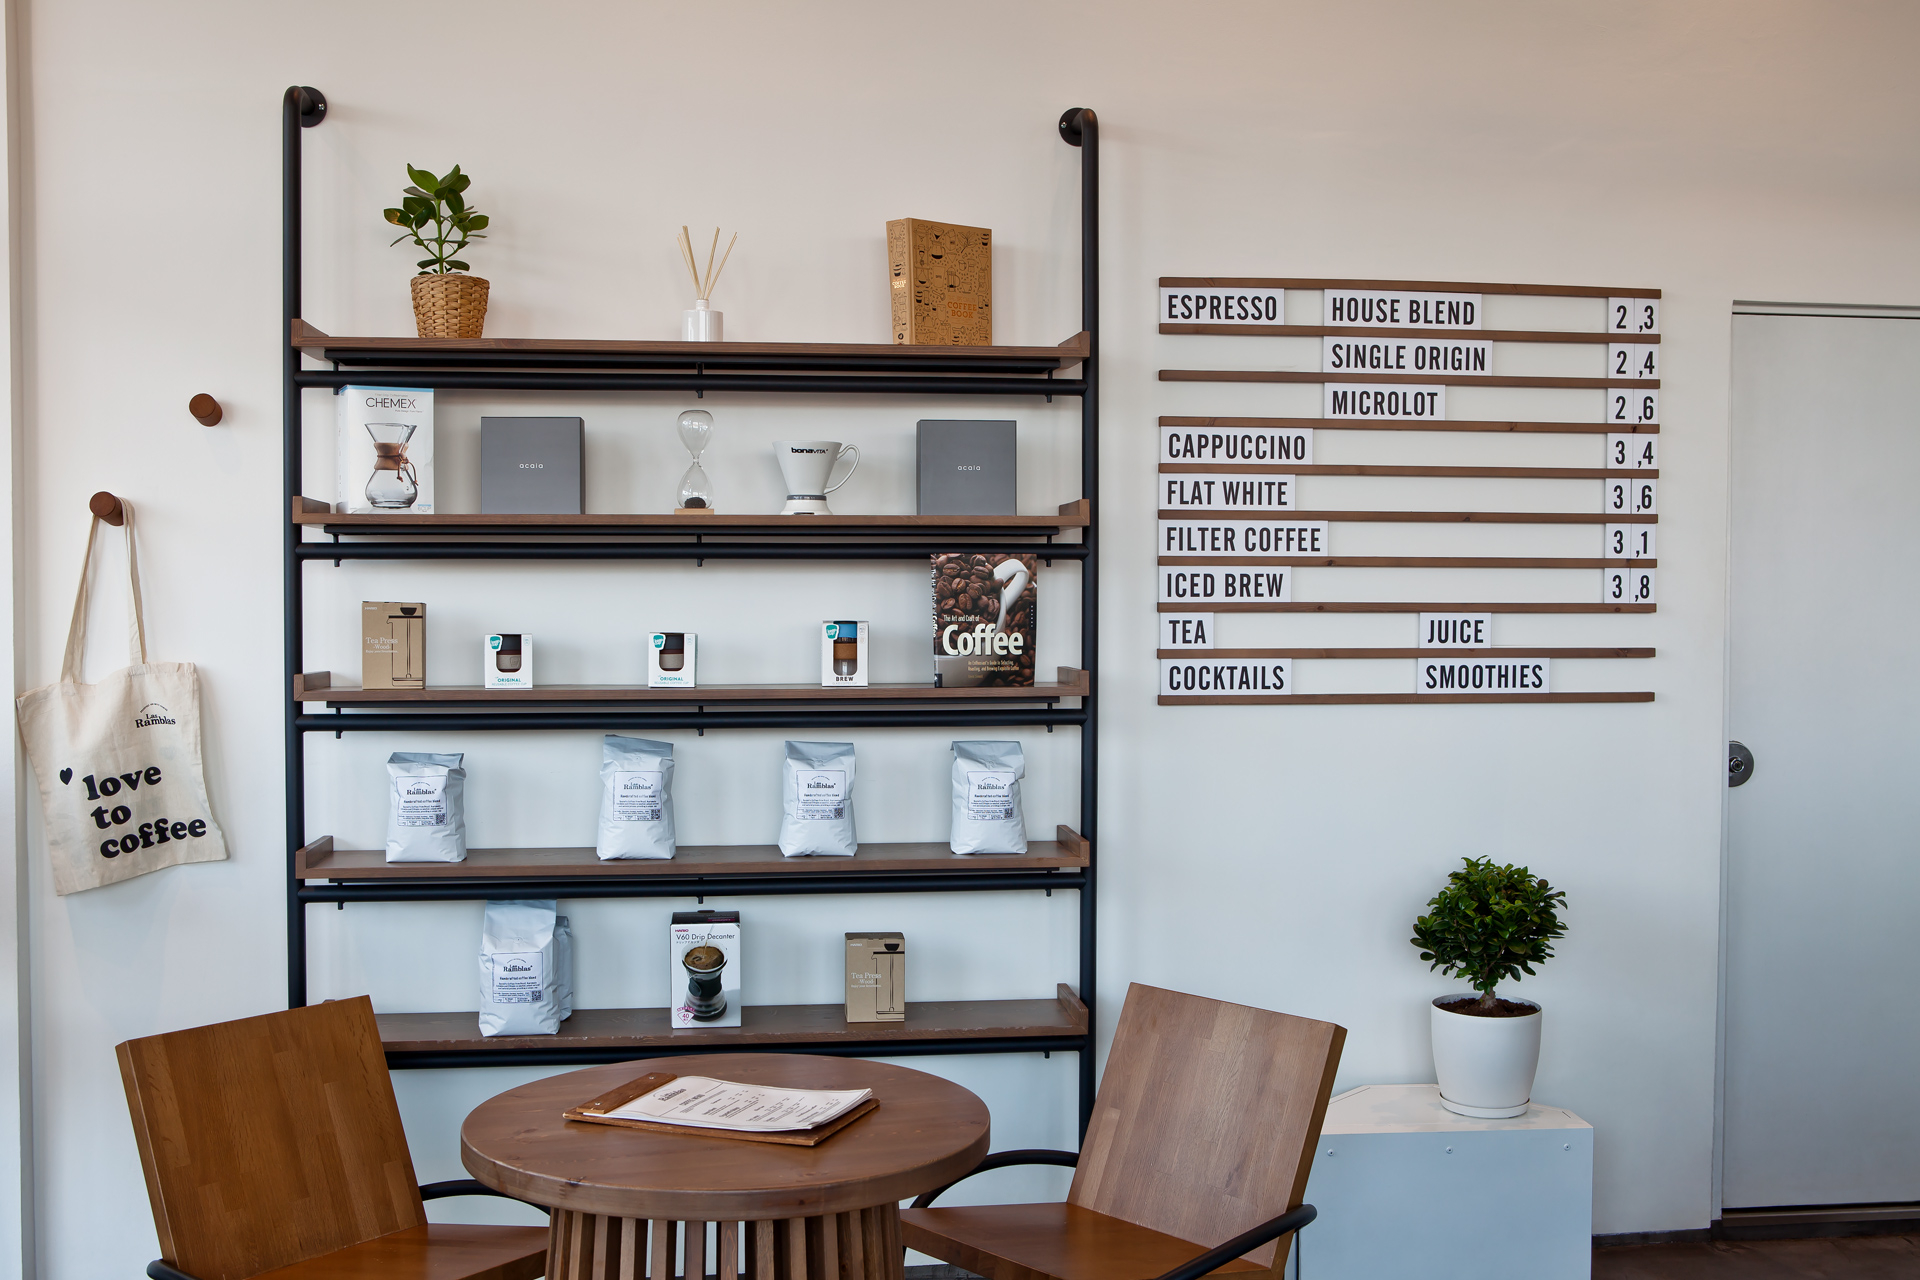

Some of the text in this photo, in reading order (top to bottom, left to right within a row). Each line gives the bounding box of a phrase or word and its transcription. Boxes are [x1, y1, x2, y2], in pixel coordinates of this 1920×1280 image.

[947, 301, 978, 312] COFFEE
[951, 310, 974, 319] BOOK
[1169, 295, 1276, 320] ESPRESSO
[1333, 298, 1400, 322] HOUSE
[1409, 300, 1475, 326] BLEND
[1332, 344, 1405, 369] SINGLE
[1415, 346, 1485, 371] ORIGIN
[365, 397, 416, 409] CHEMEX
[1333, 391, 1437, 416] MICROLOT
[1169, 434, 1305, 460] CAPPUCCINO
[1168, 481, 1215, 504] FLAT
[1223, 482, 1287, 505] WHITE
[1167, 527, 1235, 551] FILTER
[1245, 528, 1320, 551] COFFEE
[1168, 573, 1214, 597] ICED
[1225, 574, 1283, 597] BREW
[943, 614, 951, 622] The
[965, 614, 975, 622] Craft
[975, 614, 980, 622] of
[365, 637, 399, 645] Tea Press
[942, 623, 1024, 656] Coffee
[1169, 620, 1483, 643] TEA JUICE
[1170, 665, 1542, 690] COCKTAILS SMOOTHIES
[135, 716, 176, 728] Ramblas
[82, 766, 162, 801] love
[90, 805, 132, 830] to
[99, 817, 207, 859] coffee
[691, 933, 706, 942] Drip
